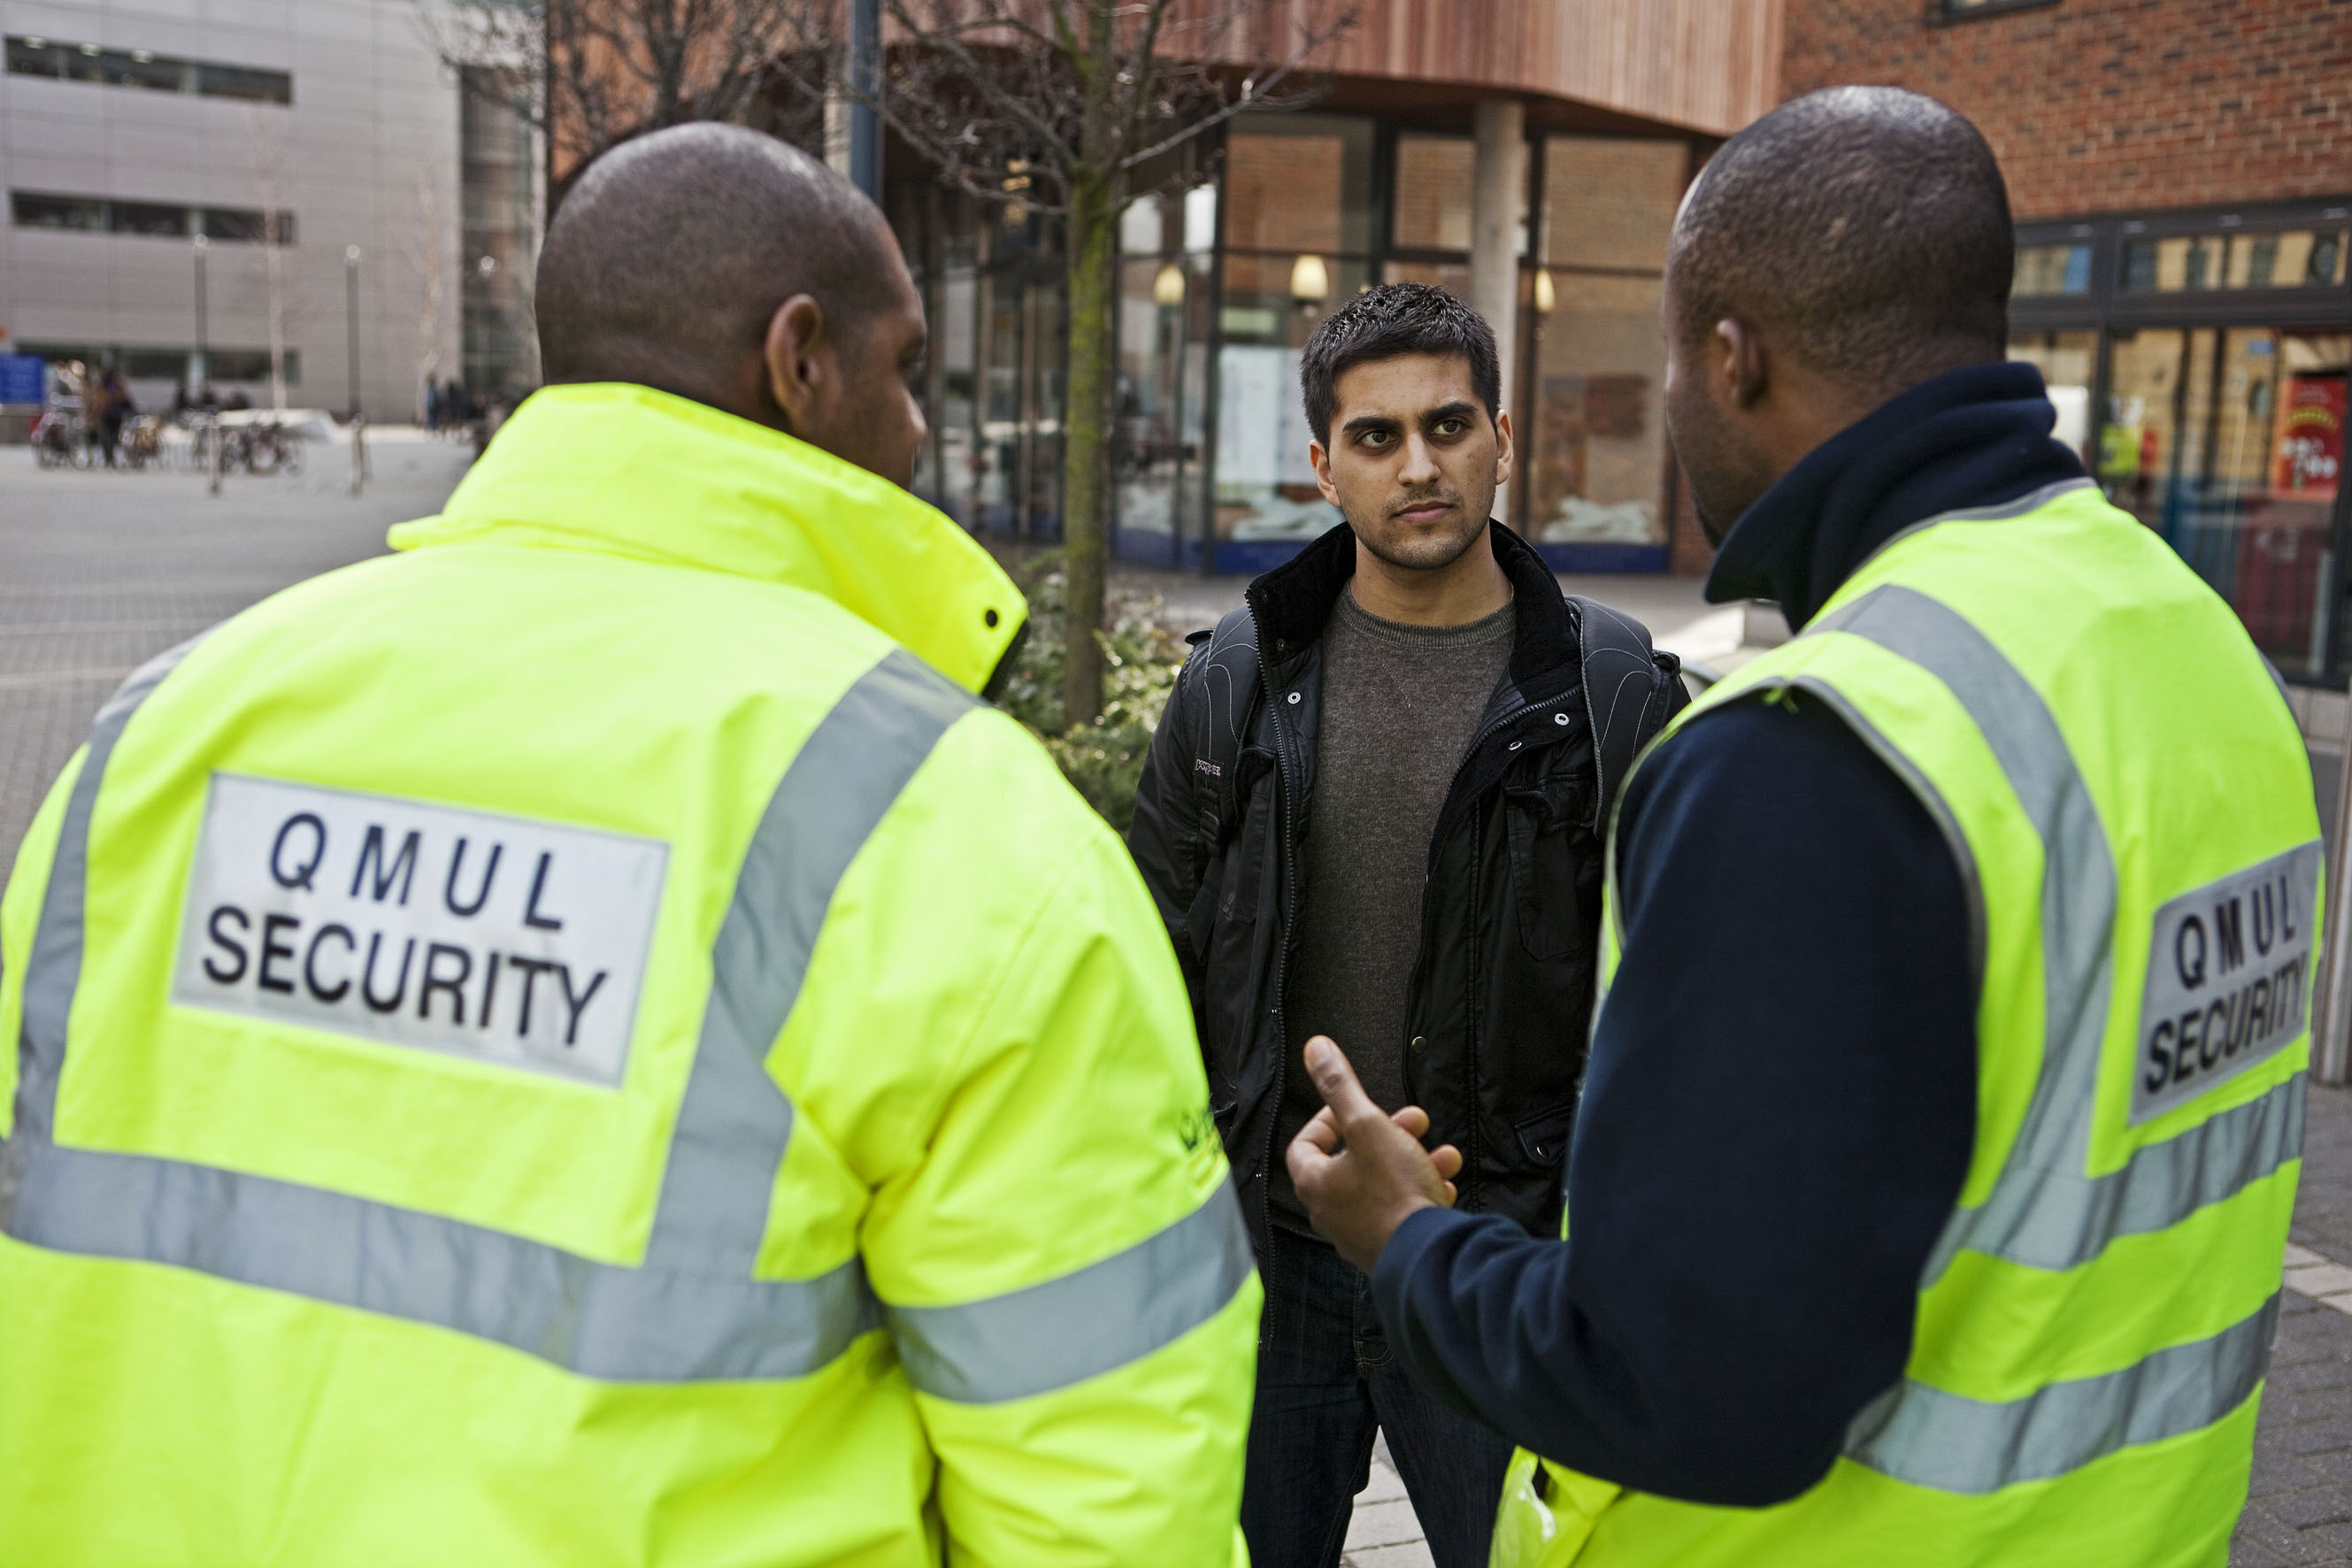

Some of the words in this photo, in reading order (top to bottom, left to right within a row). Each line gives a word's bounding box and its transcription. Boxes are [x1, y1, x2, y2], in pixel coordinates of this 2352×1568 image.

[269, 811, 564, 932] QMUL
[2175, 875, 2296, 991] QMUL
[203, 905, 608, 1046] SECURITY
[2145, 950, 2309, 1095] SECURITY
